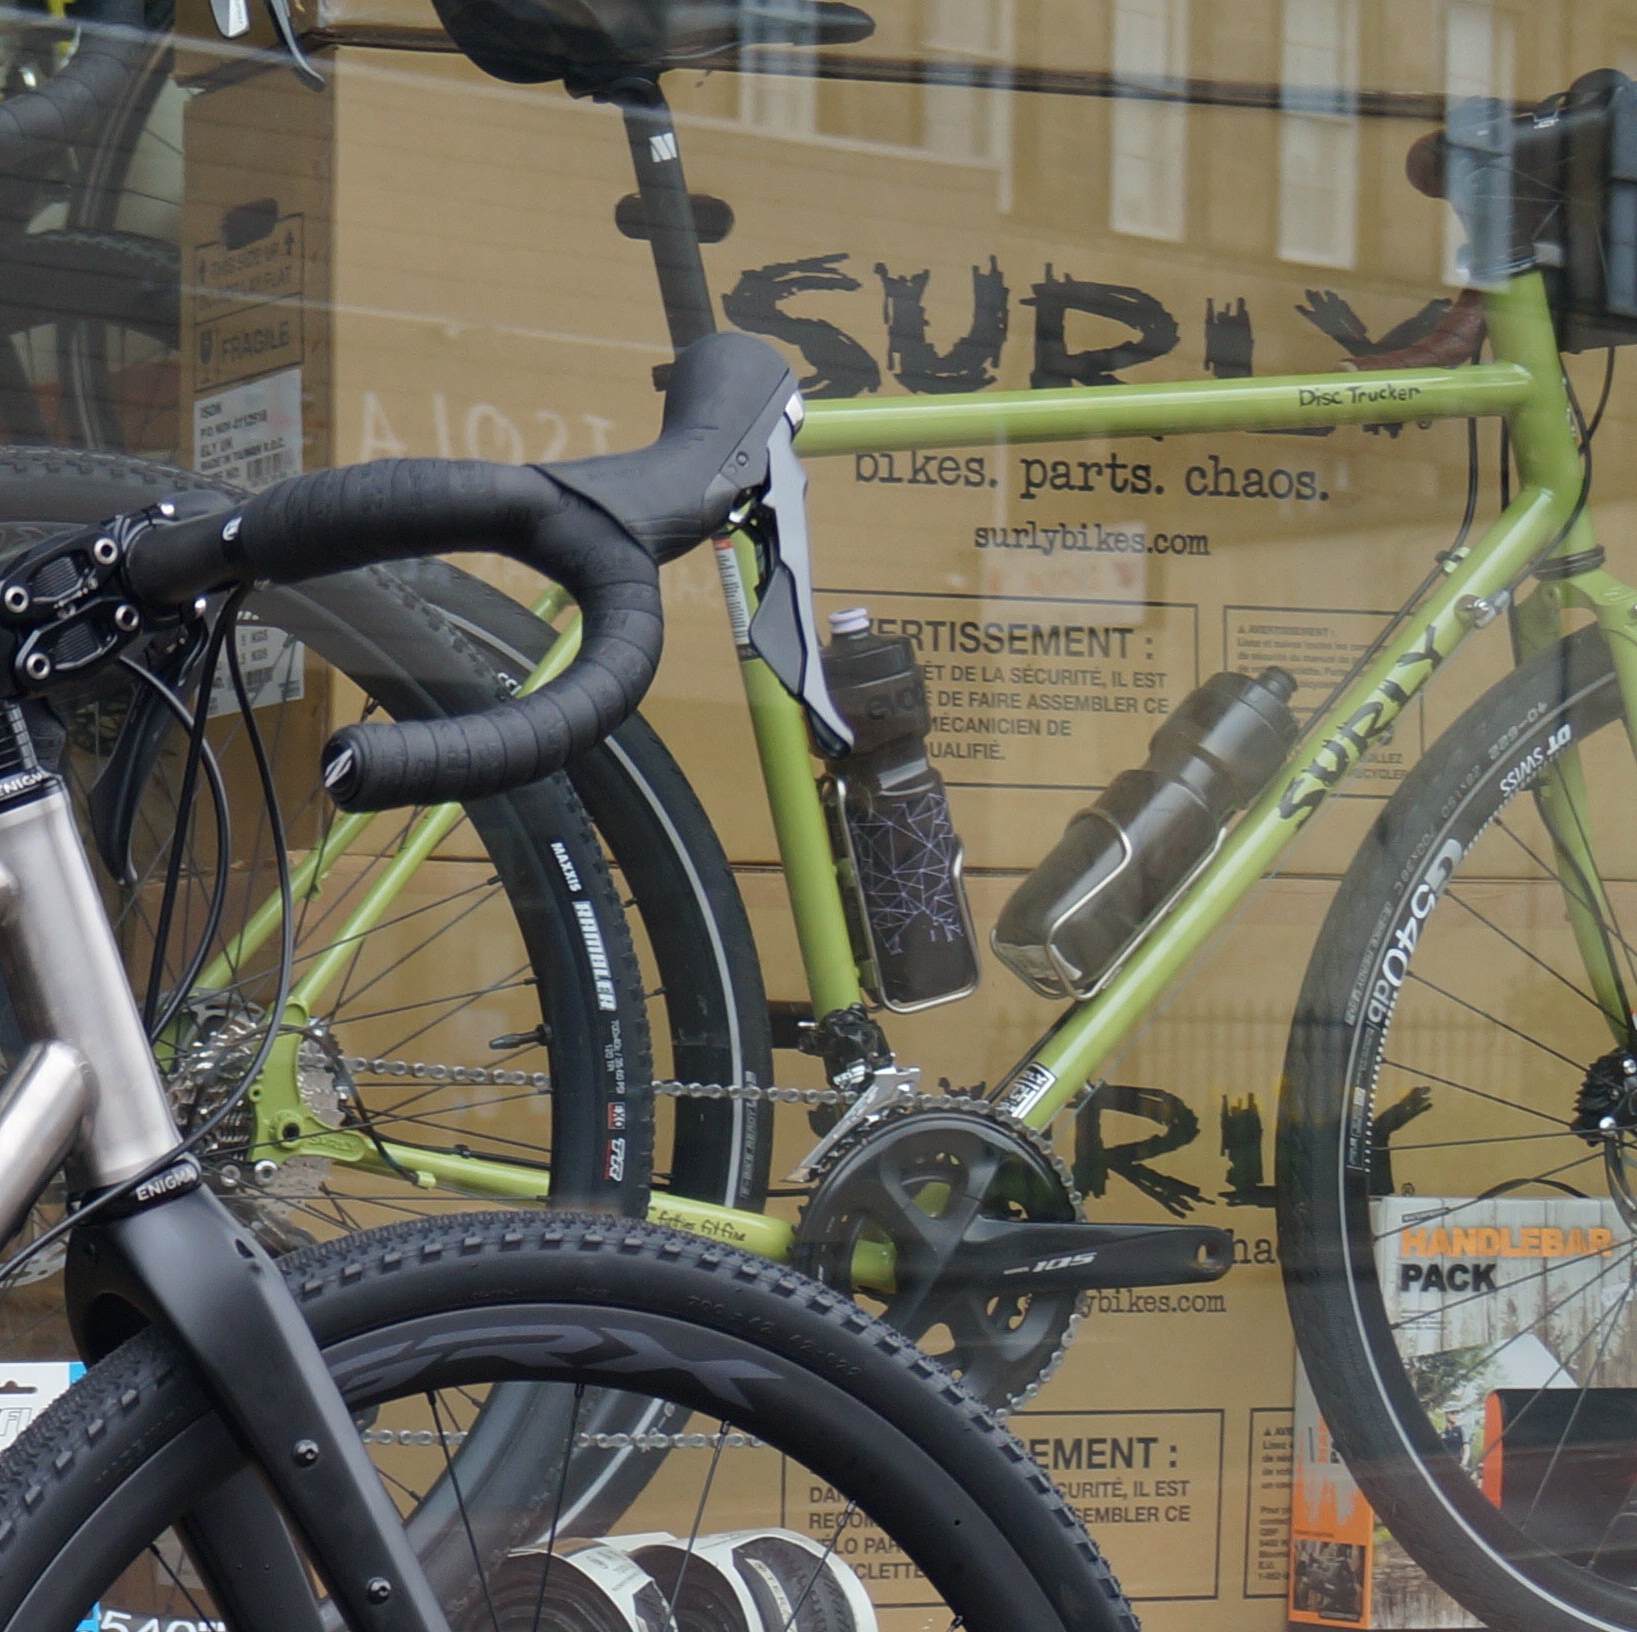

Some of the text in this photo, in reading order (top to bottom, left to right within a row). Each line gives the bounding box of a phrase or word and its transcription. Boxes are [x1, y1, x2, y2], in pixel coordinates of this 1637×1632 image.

[220, 323, 290, 358] FRAGILE
[723, 252, 1455, 440] SURLY
[1298, 384, 1422, 408] Disc Trucker
[855, 449, 1330, 502] bikes. parts. chaos.
[974, 521, 1211, 557] surlybikes.com
[868, 618, 1134, 658] ERTISSEMENT
[951, 667, 976, 682] DE
[982, 667, 1004, 683] LA
[1011, 666, 1106, 689] SÉCURITÉ,
[1113, 672, 1127, 687] IL
[1133, 672, 1167, 688] EST
[938, 692, 964, 707] DE
[969, 692, 1021, 709] FAIRE
[1027, 694, 1139, 714] ASSEMBLER
[1144, 697, 1169, 714] CE
[1046, 720, 1071, 736] DE
[1278, 623, 1442, 827] SURLY
[930, 740, 1004, 759] UALIFIÉ.
[1499, 723, 1572, 797] DT SWISS
[550, 842, 582, 892] MAXXIS
[572, 901, 617, 1012] RAMBLER
[135, 1166, 198, 1202] ENIGMA
[1400, 1226, 1615, 1259] HANDLEBAR
[1032, 1252, 1098, 1274] 105
[1400, 1263, 1498, 1292] PACK
[1079, 1288, 1226, 1316] ybikes.com
[1059, 1477, 1190, 1501] CURITÉ, IL EST
[1077, 1505, 1191, 1524] SEMBLER CE
[859, 1563, 925, 1580] CLETTE
